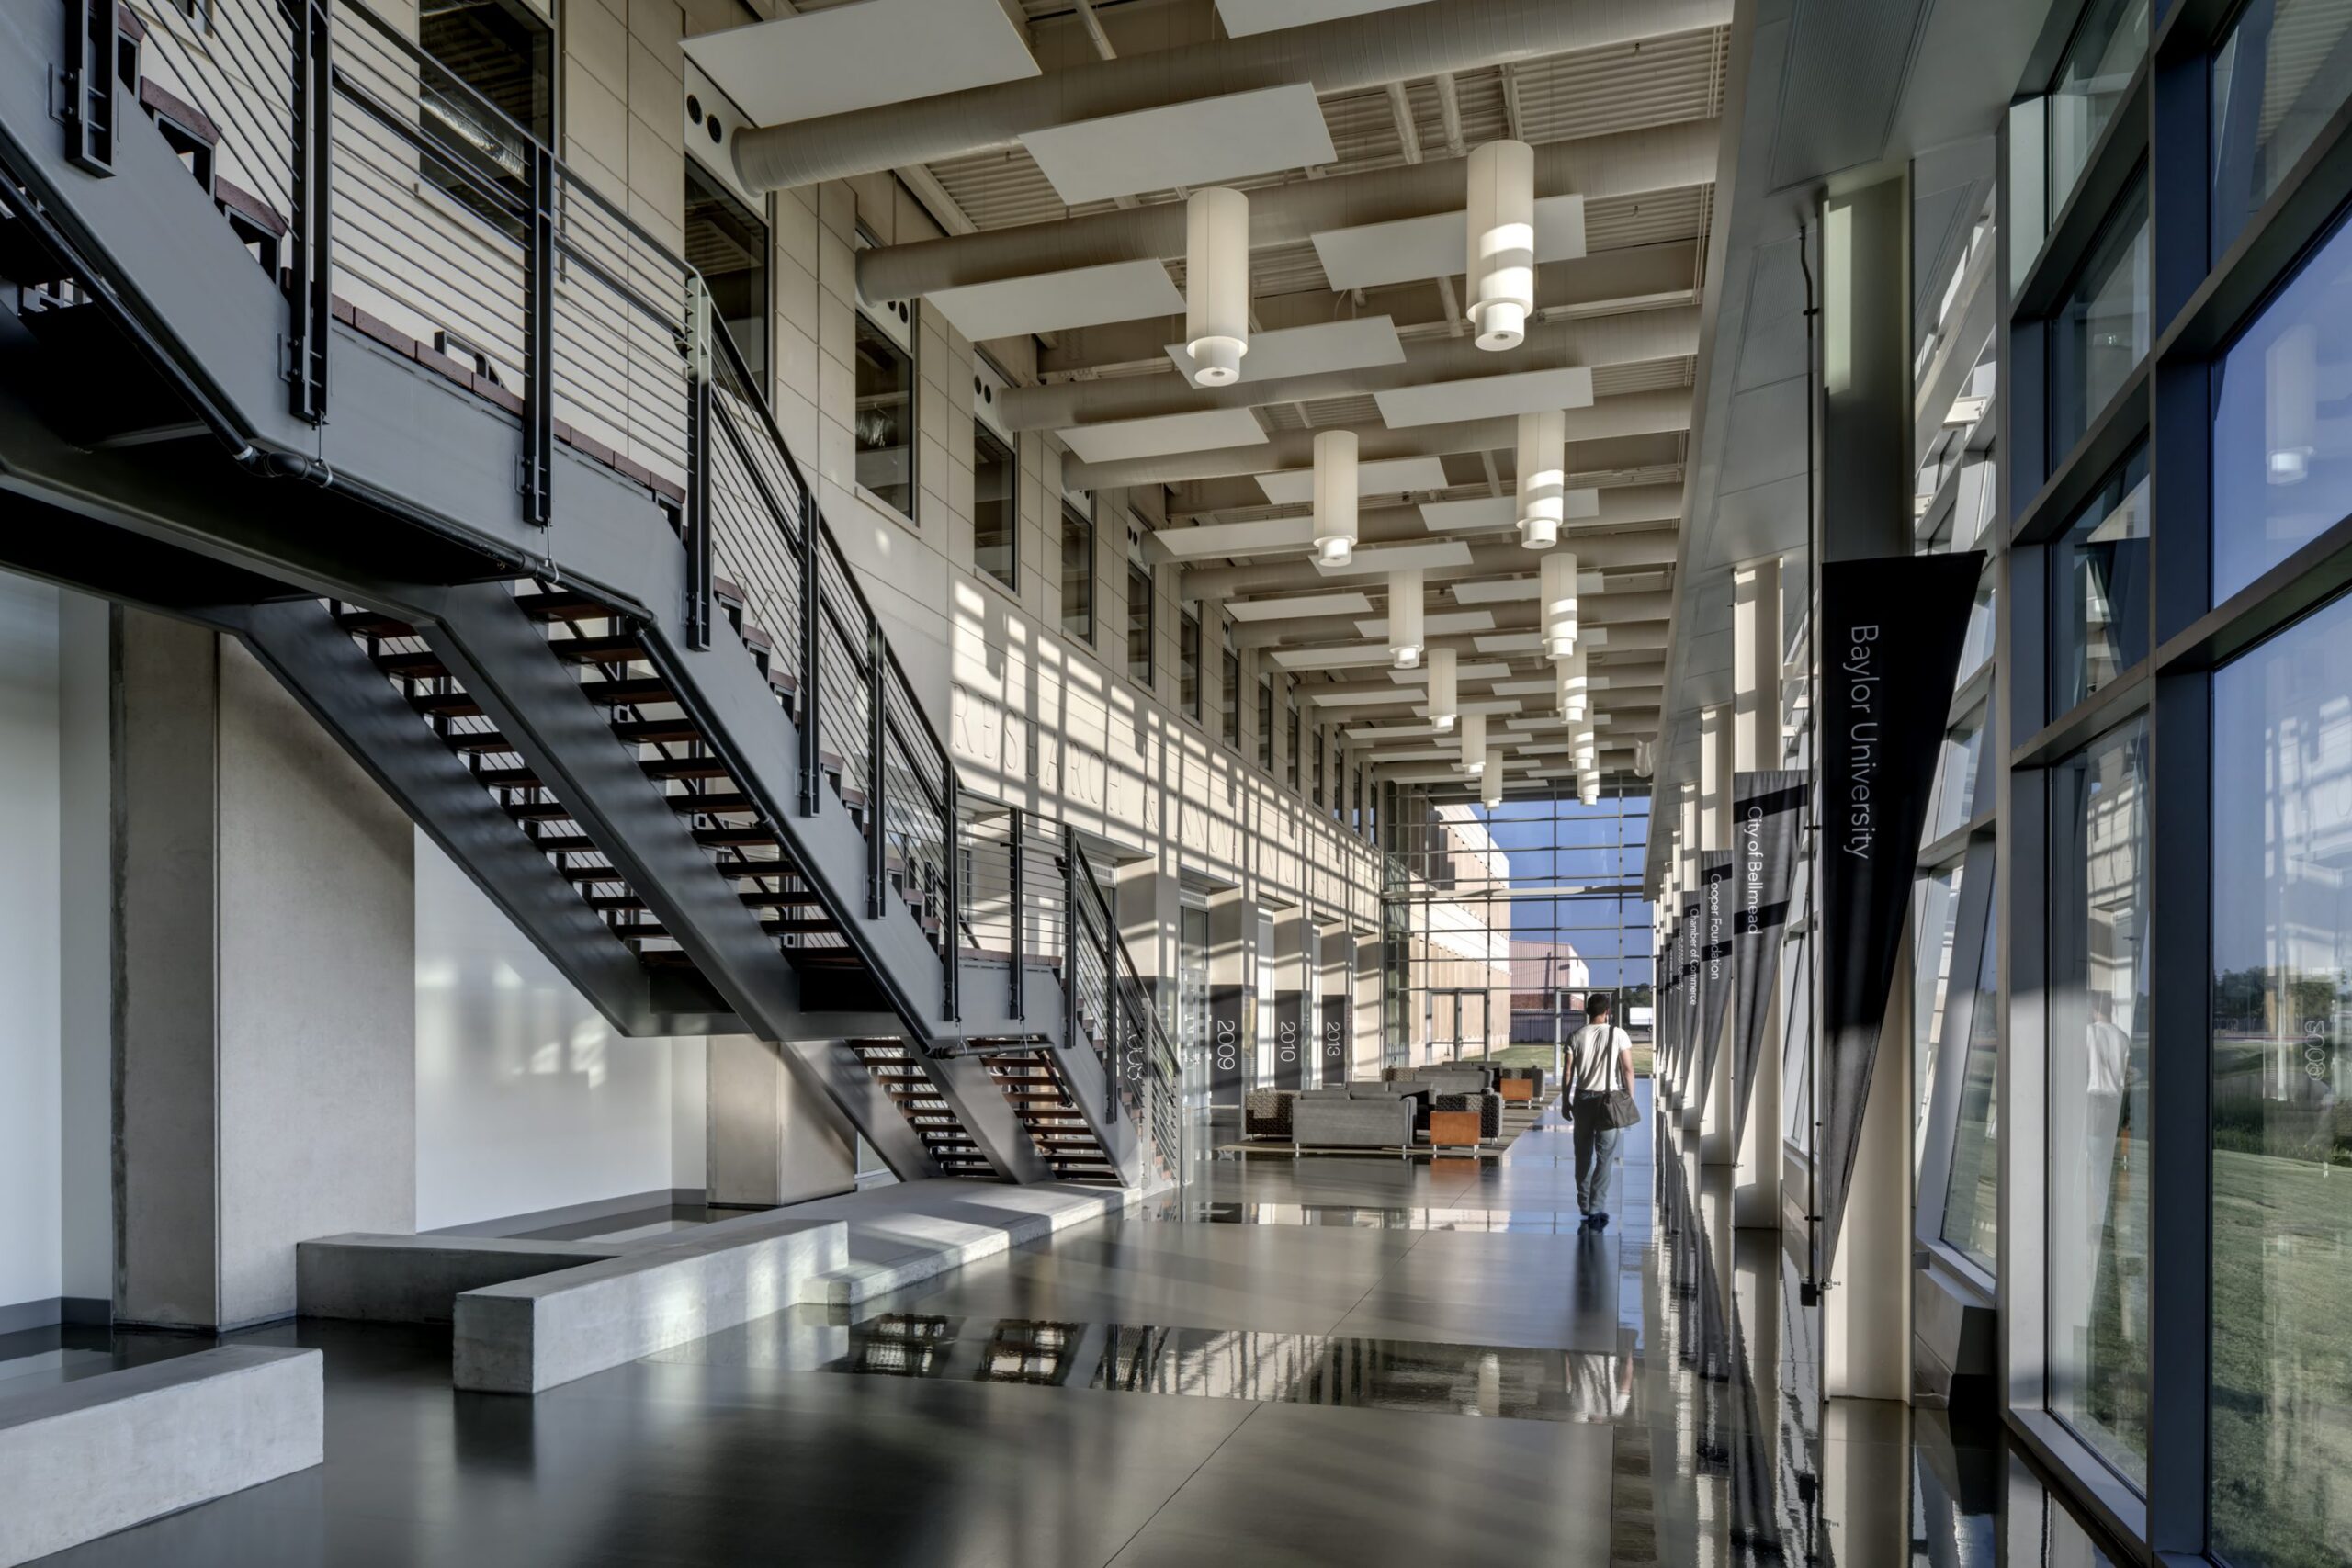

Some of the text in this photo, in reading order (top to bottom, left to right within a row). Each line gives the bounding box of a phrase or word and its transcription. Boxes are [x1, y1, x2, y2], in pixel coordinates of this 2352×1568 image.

[950, 680, 1123, 816] RESEARCH
[1843, 625, 1880, 859] Baylor University
[1745, 806, 1763, 935] City of Bellmead
[1690, 908, 1700, 947] Chamber
[1708, 874, 1722, 980] Cooper Foundation
[1690, 960, 1699, 1006] Commerce
[1217, 1020, 1236, 1070] 2009
[1280, 1021, 1296, 1062] 2010
[1326, 1021, 1340, 1057] 2013
